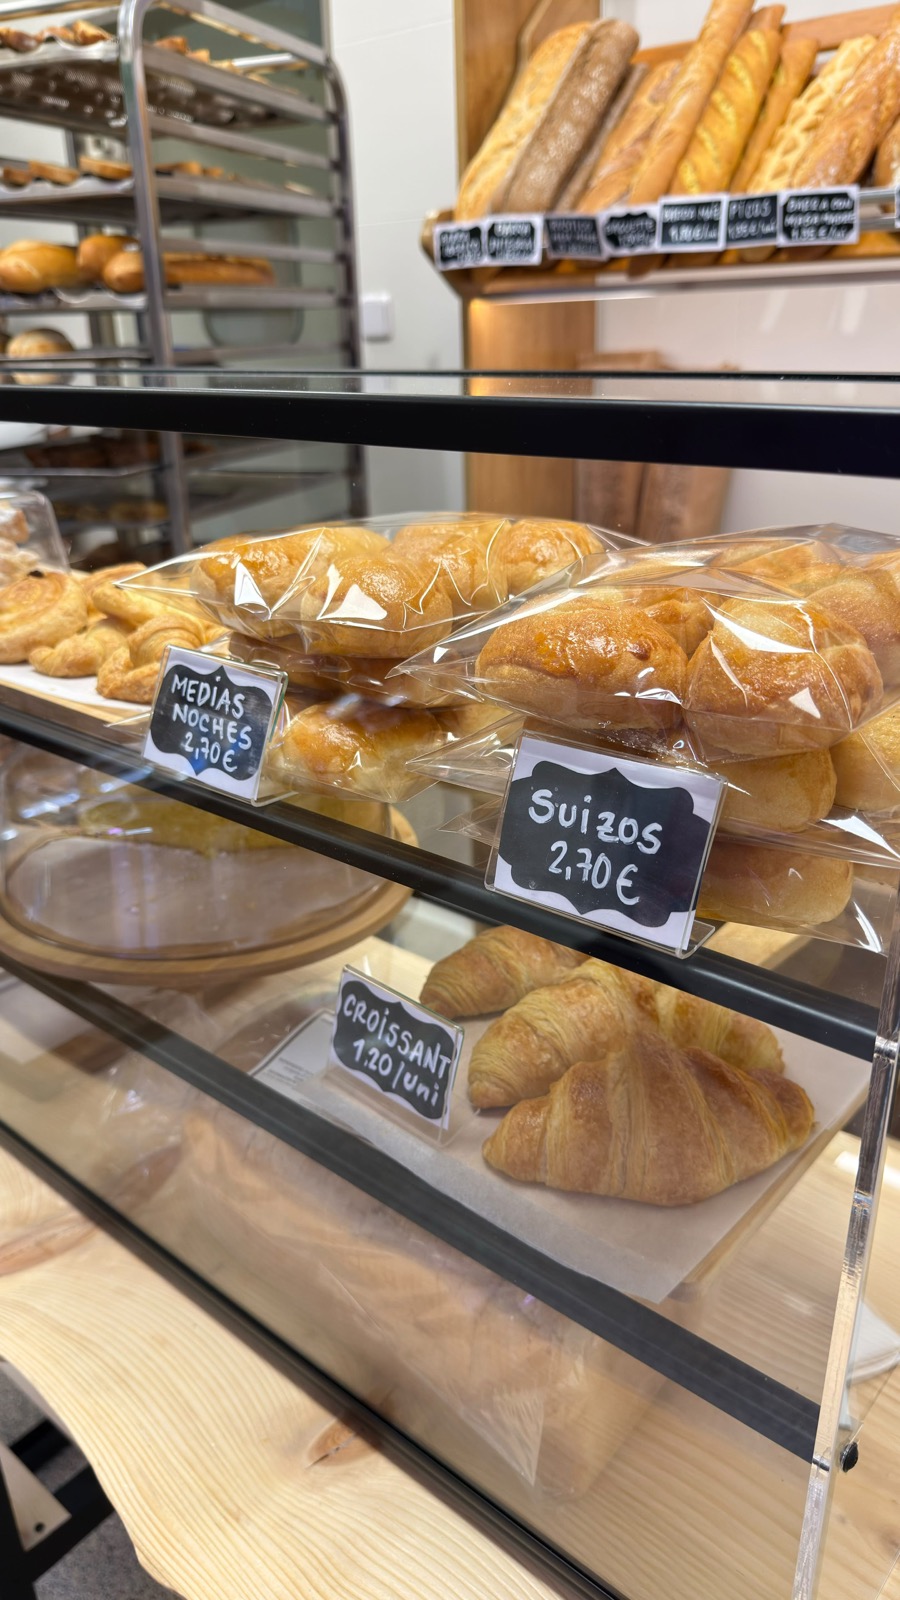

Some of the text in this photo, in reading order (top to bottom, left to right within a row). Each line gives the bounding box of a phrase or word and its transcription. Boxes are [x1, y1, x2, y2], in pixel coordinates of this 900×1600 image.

[171, 674, 246, 720] MEDIAS
[172, 703, 252, 750] NOCHES
[528, 788, 663, 855] Suizos
[343, 994, 452, 1079] CROISSANT
